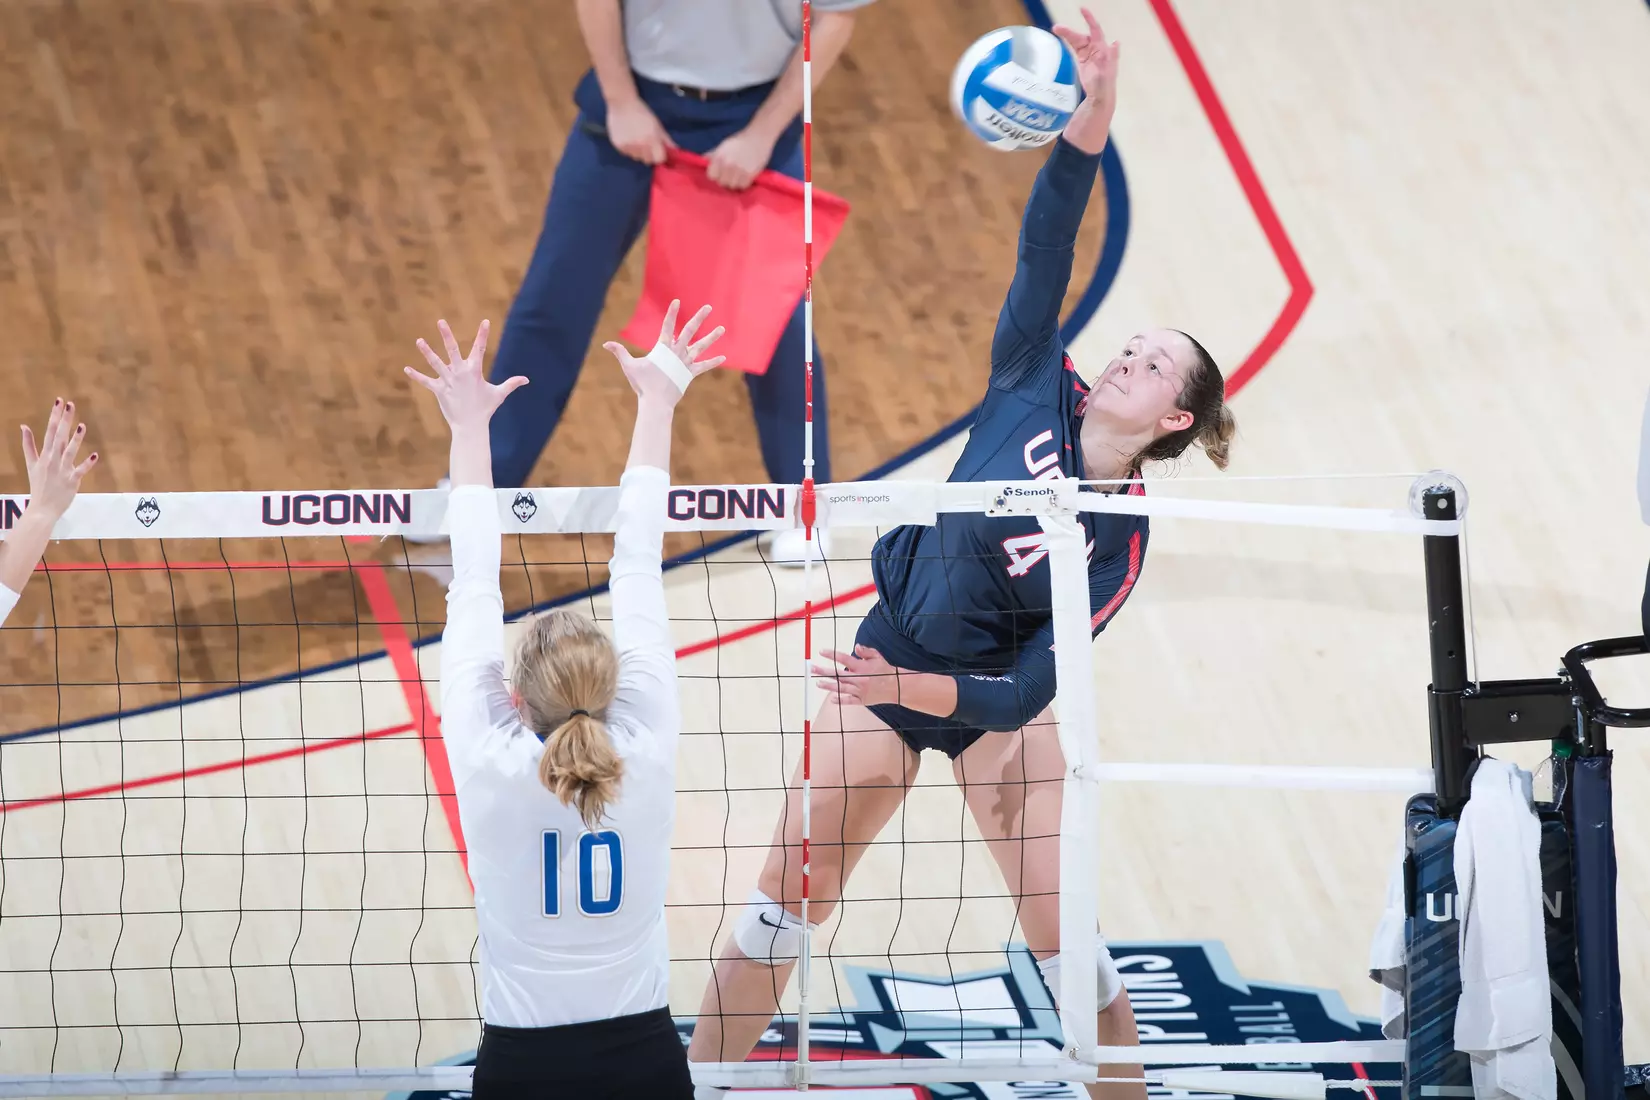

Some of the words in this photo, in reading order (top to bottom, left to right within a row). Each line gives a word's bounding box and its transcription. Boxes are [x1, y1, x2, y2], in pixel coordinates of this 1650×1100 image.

[986, 113, 1051, 143] molten
[1000, 99, 1058, 129] NCAA
[667, 488, 785, 521] CONN
[1014, 487, 1054, 497] Senoh
[262, 493, 411, 526] UCONN
[1001, 531, 1049, 578] 4
[542, 829, 625, 917] 10
